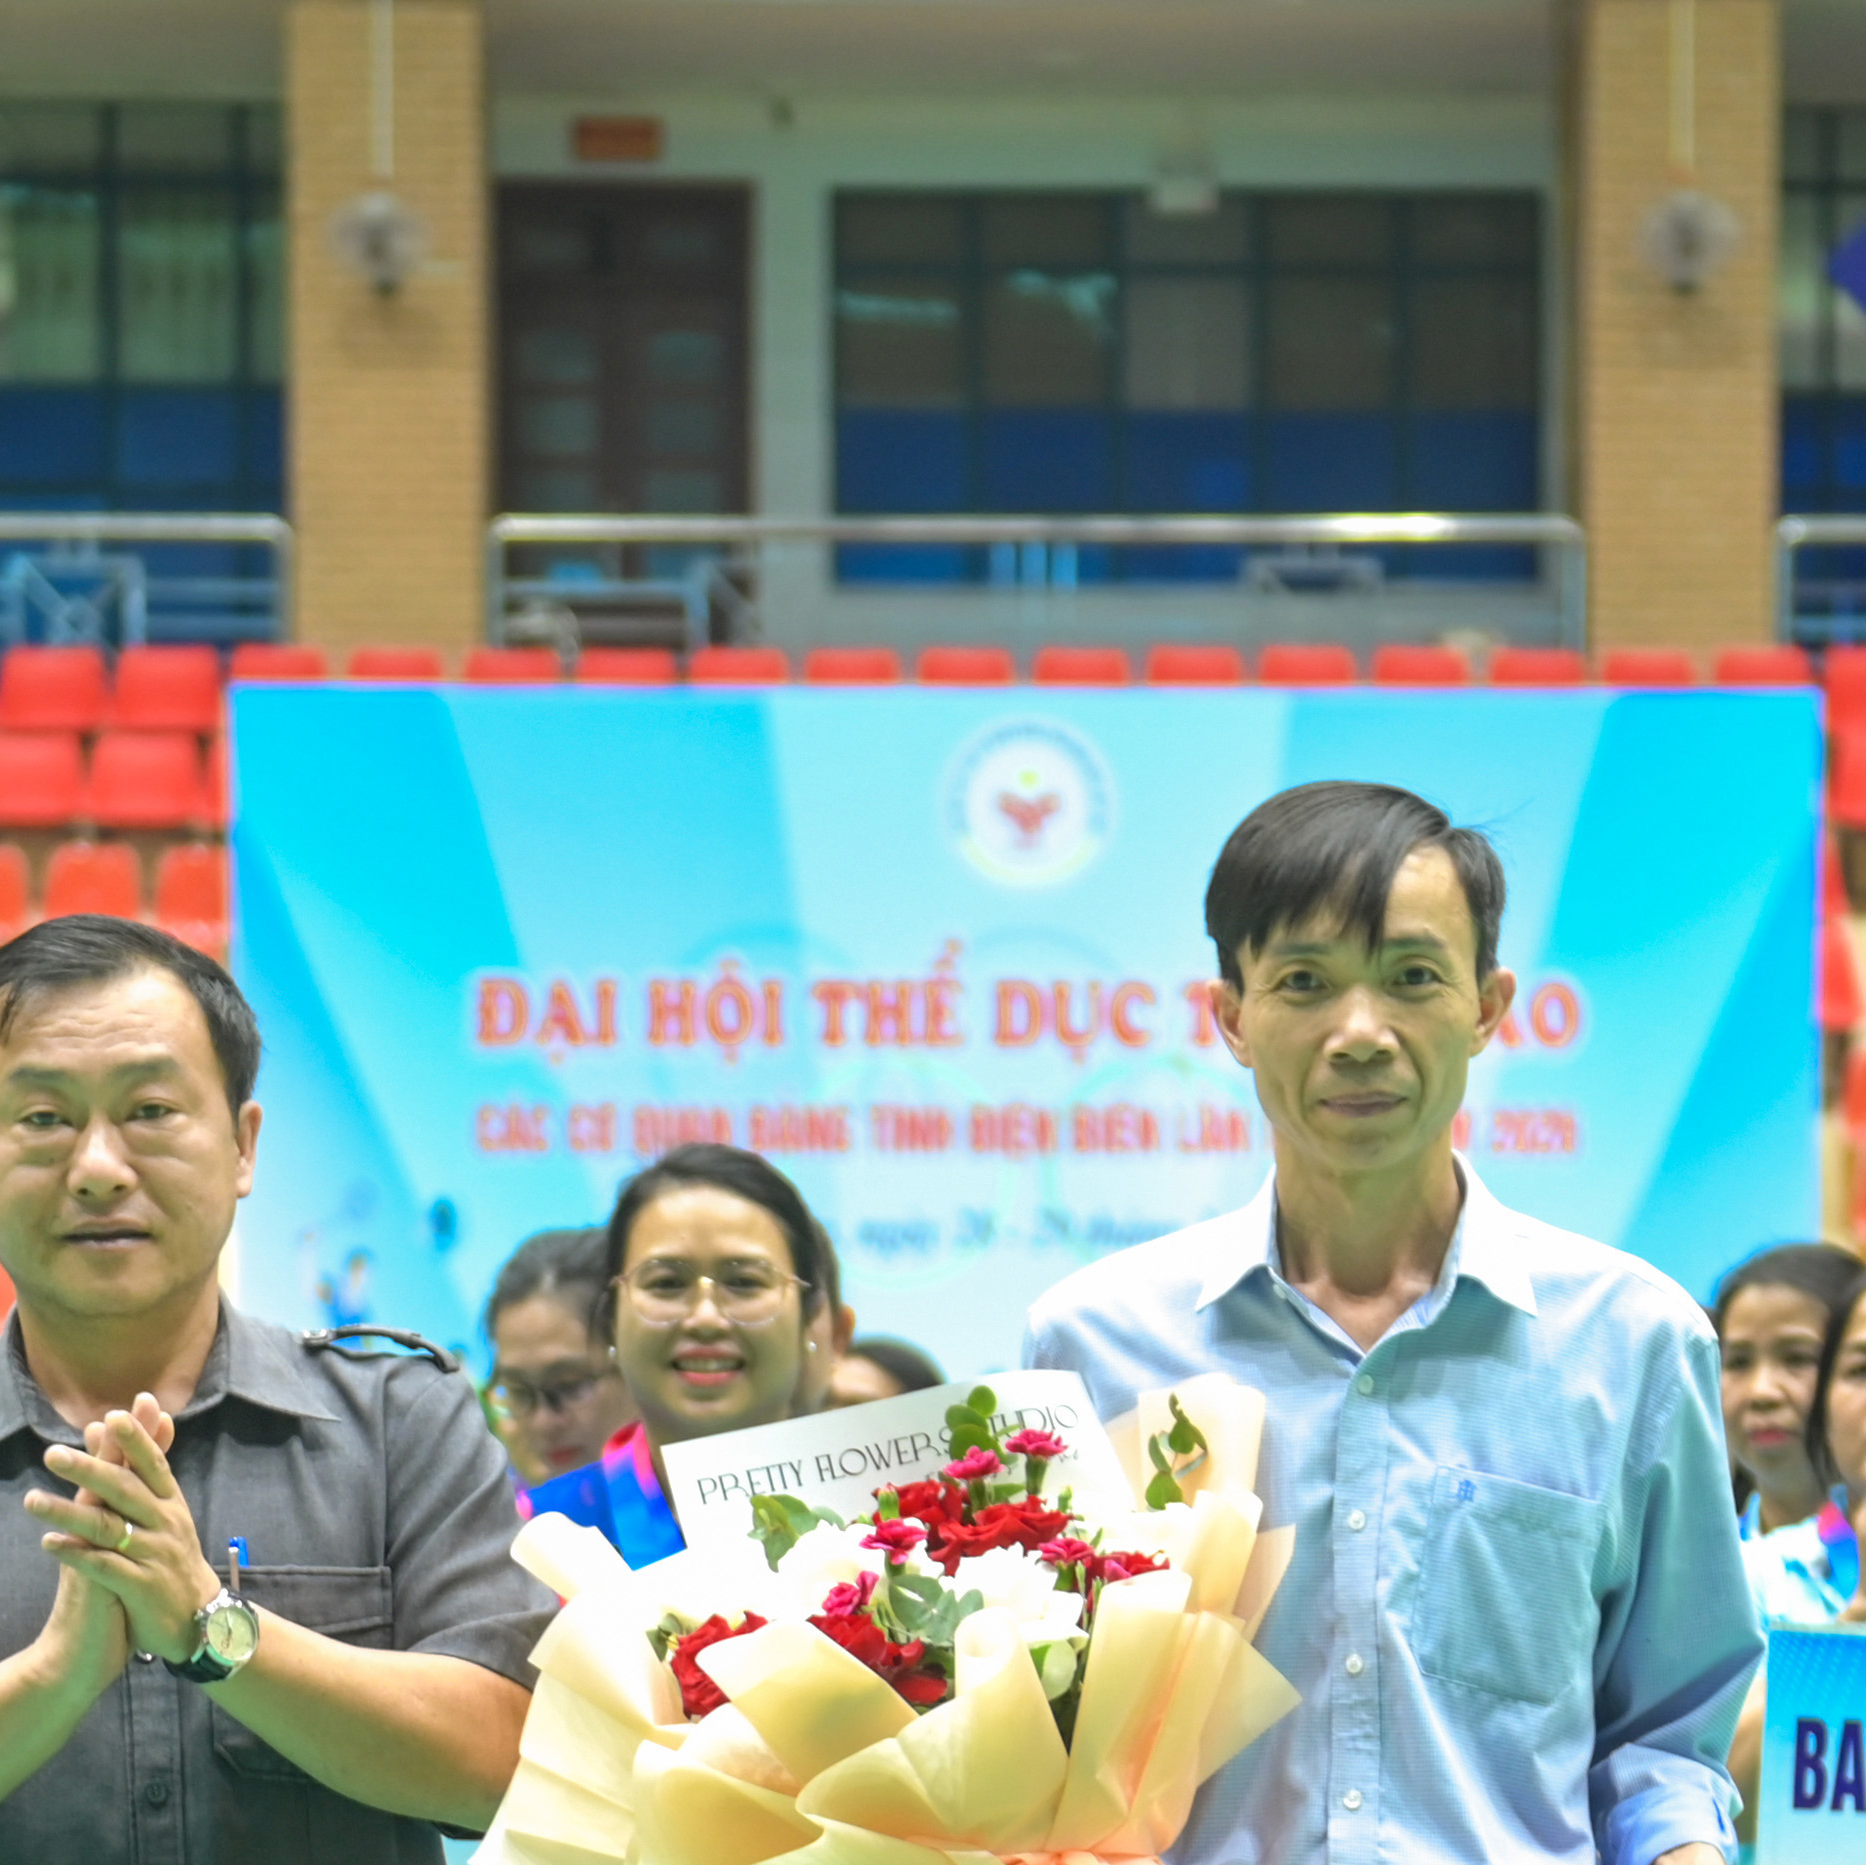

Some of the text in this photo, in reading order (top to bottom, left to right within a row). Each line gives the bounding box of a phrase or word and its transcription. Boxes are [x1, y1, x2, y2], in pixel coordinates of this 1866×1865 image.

[477, 979, 617, 1064] ĐẠI
[648, 958, 783, 1064] HỘI
[812, 940, 965, 1046] THỂ
[995, 980, 1155, 1062] DỤC
[697, 1459, 803, 1505] PRETTY
